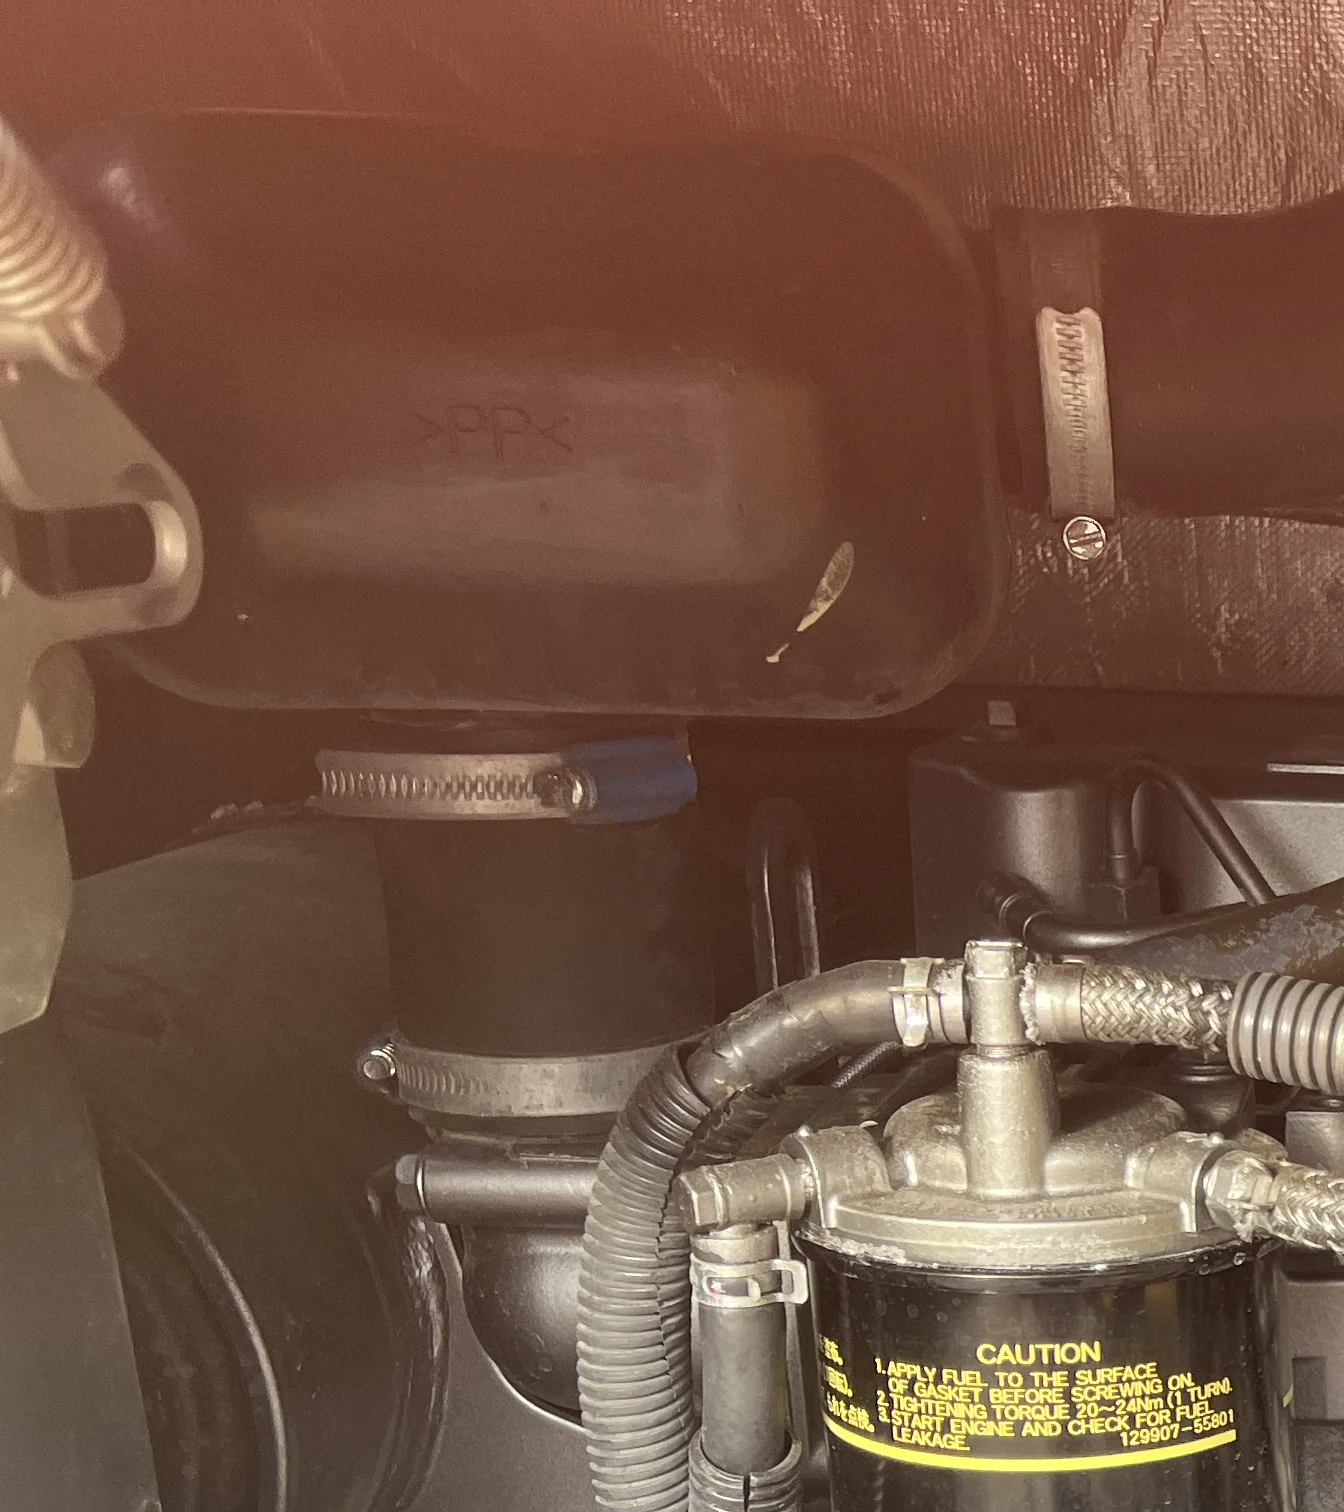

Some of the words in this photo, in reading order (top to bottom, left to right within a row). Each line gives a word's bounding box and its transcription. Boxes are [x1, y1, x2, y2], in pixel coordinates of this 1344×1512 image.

[976, 1341, 1101, 1365] CAUTION
[887, 1360, 936, 1383] APPLY
[941, 1368, 989, 1387] FUEL
[994, 1371, 1024, 1387] TO
[1029, 1370, 1070, 1388] THE
[1074, 1362, 1159, 1386] SURFACE
[887, 1377, 909, 1393] OF
[913, 1382, 984, 1403] GASKET
[988, 1387, 1066, 1404] BEFORE
[1070, 1378, 1164, 1403] SCREWING
[888, 1392, 988, 1419] TIGHTENING
[991, 1403, 1071, 1421] TORQUE
[891, 1410, 945, 1432] START
[950, 1418, 1016, 1437] ENGINE
[1021, 1419, 1063, 1437] AND
[1067, 1414, 1130, 1436] CHECK
[1135, 1408, 1172, 1429] FOR
[1176, 1400, 1215, 1422] FUEL
[1120, 1408, 1235, 1447] 129907-55801
